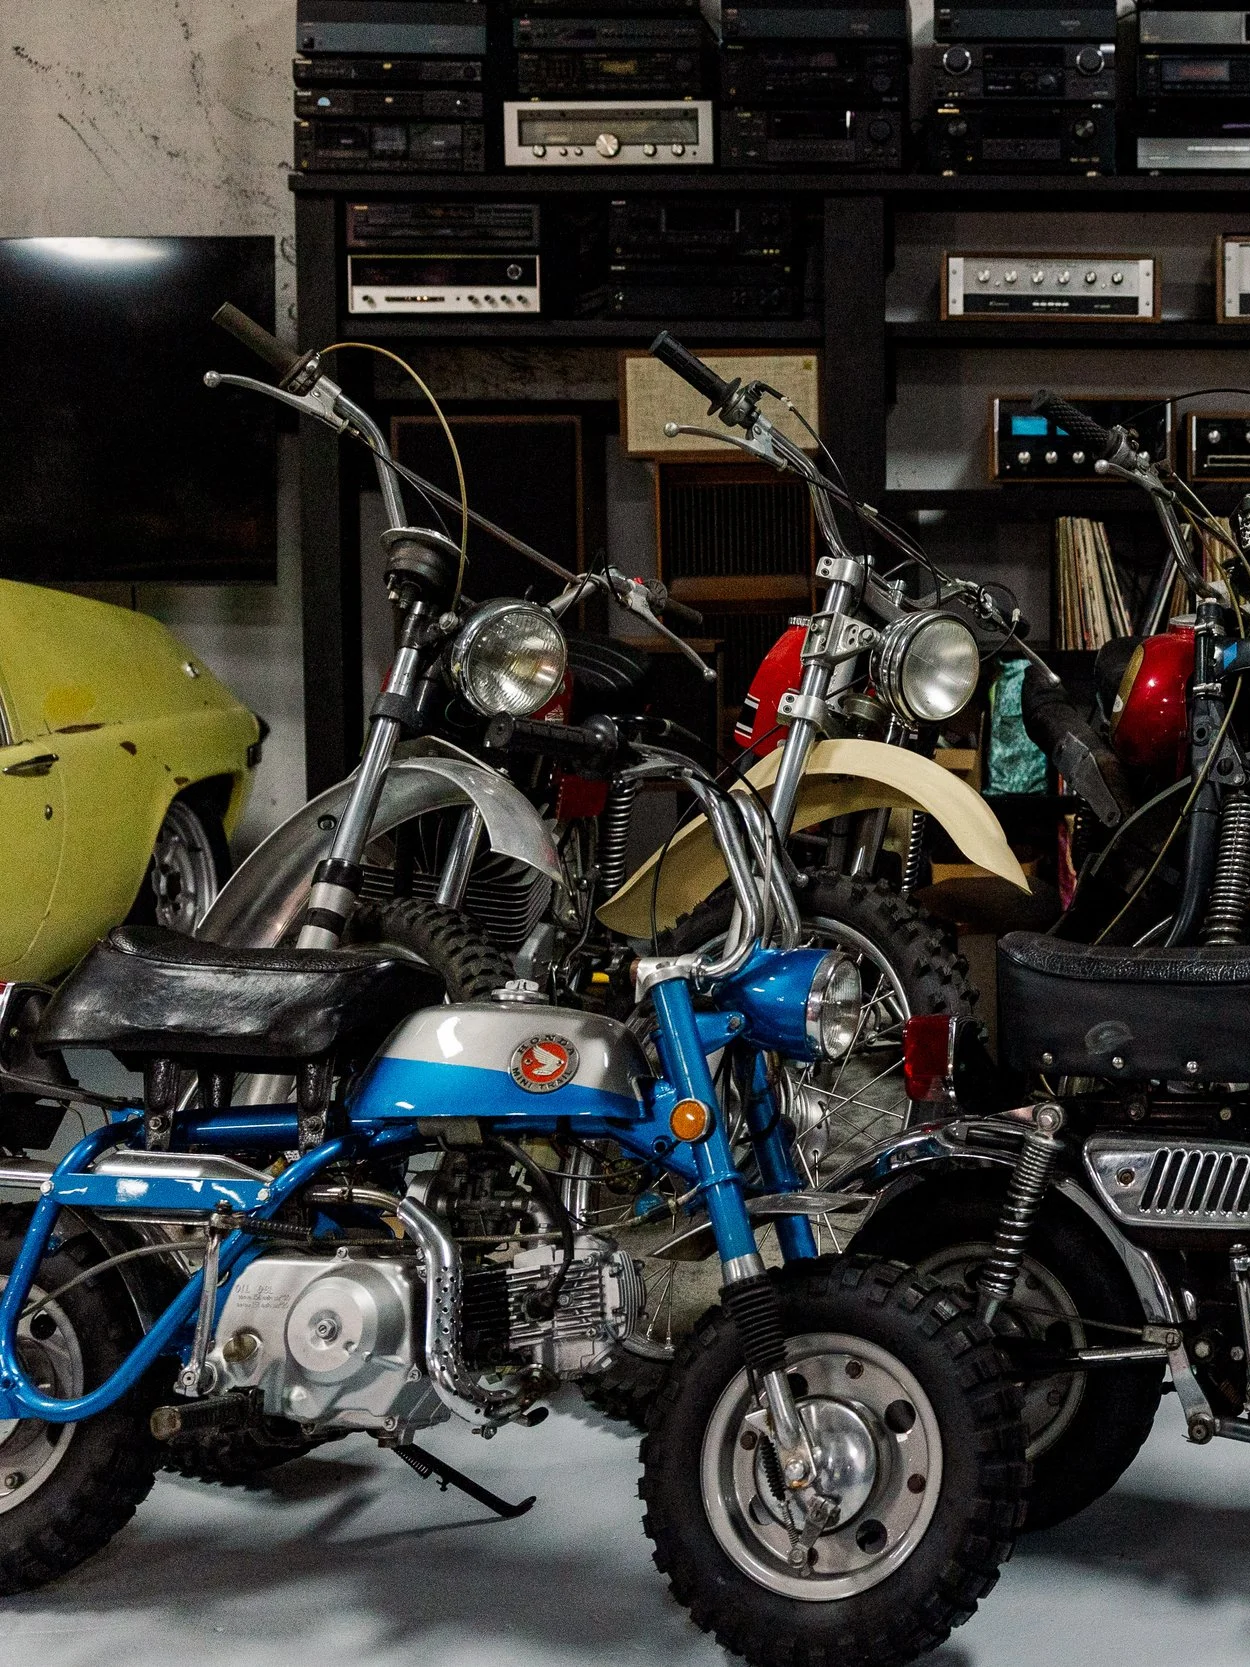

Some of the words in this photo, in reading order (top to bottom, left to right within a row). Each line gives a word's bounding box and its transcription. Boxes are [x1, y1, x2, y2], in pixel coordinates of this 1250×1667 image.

[517, 1034, 575, 1055] HONDA
[512, 1067, 532, 1089] MINI
[538, 1070, 573, 1090] TRAIL
